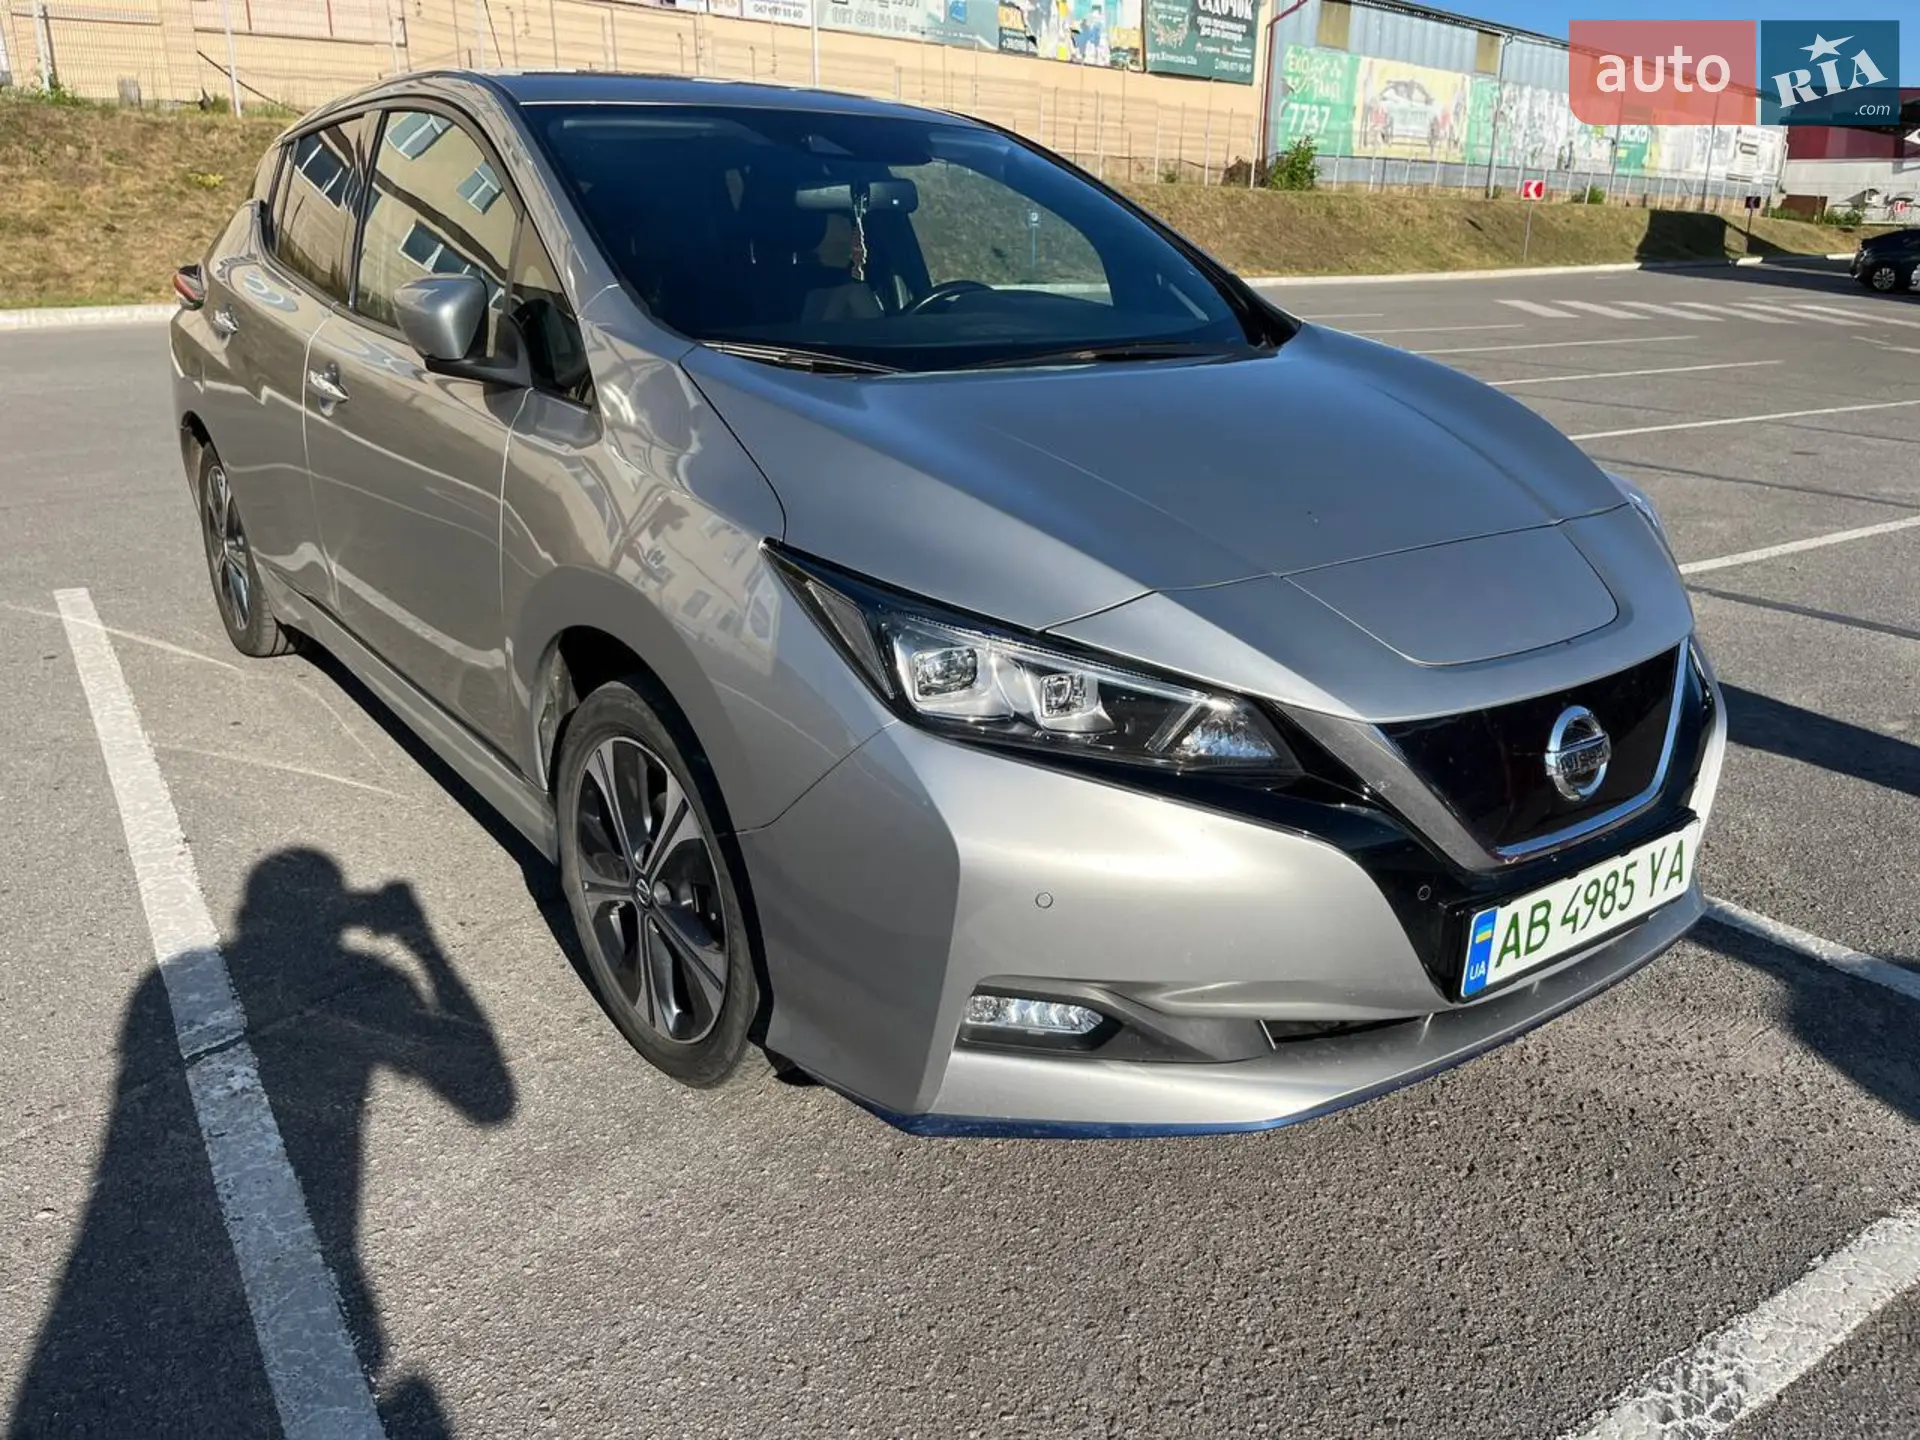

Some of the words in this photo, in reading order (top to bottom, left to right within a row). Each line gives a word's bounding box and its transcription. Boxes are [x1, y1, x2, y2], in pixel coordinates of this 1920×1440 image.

[1288, 102, 1331, 134] 7737
[1495, 899, 1552, 969] AB
[1560, 861, 1638, 935] 4985
[1650, 839, 1684, 898] YA
[1470, 962, 1486, 981] UA
